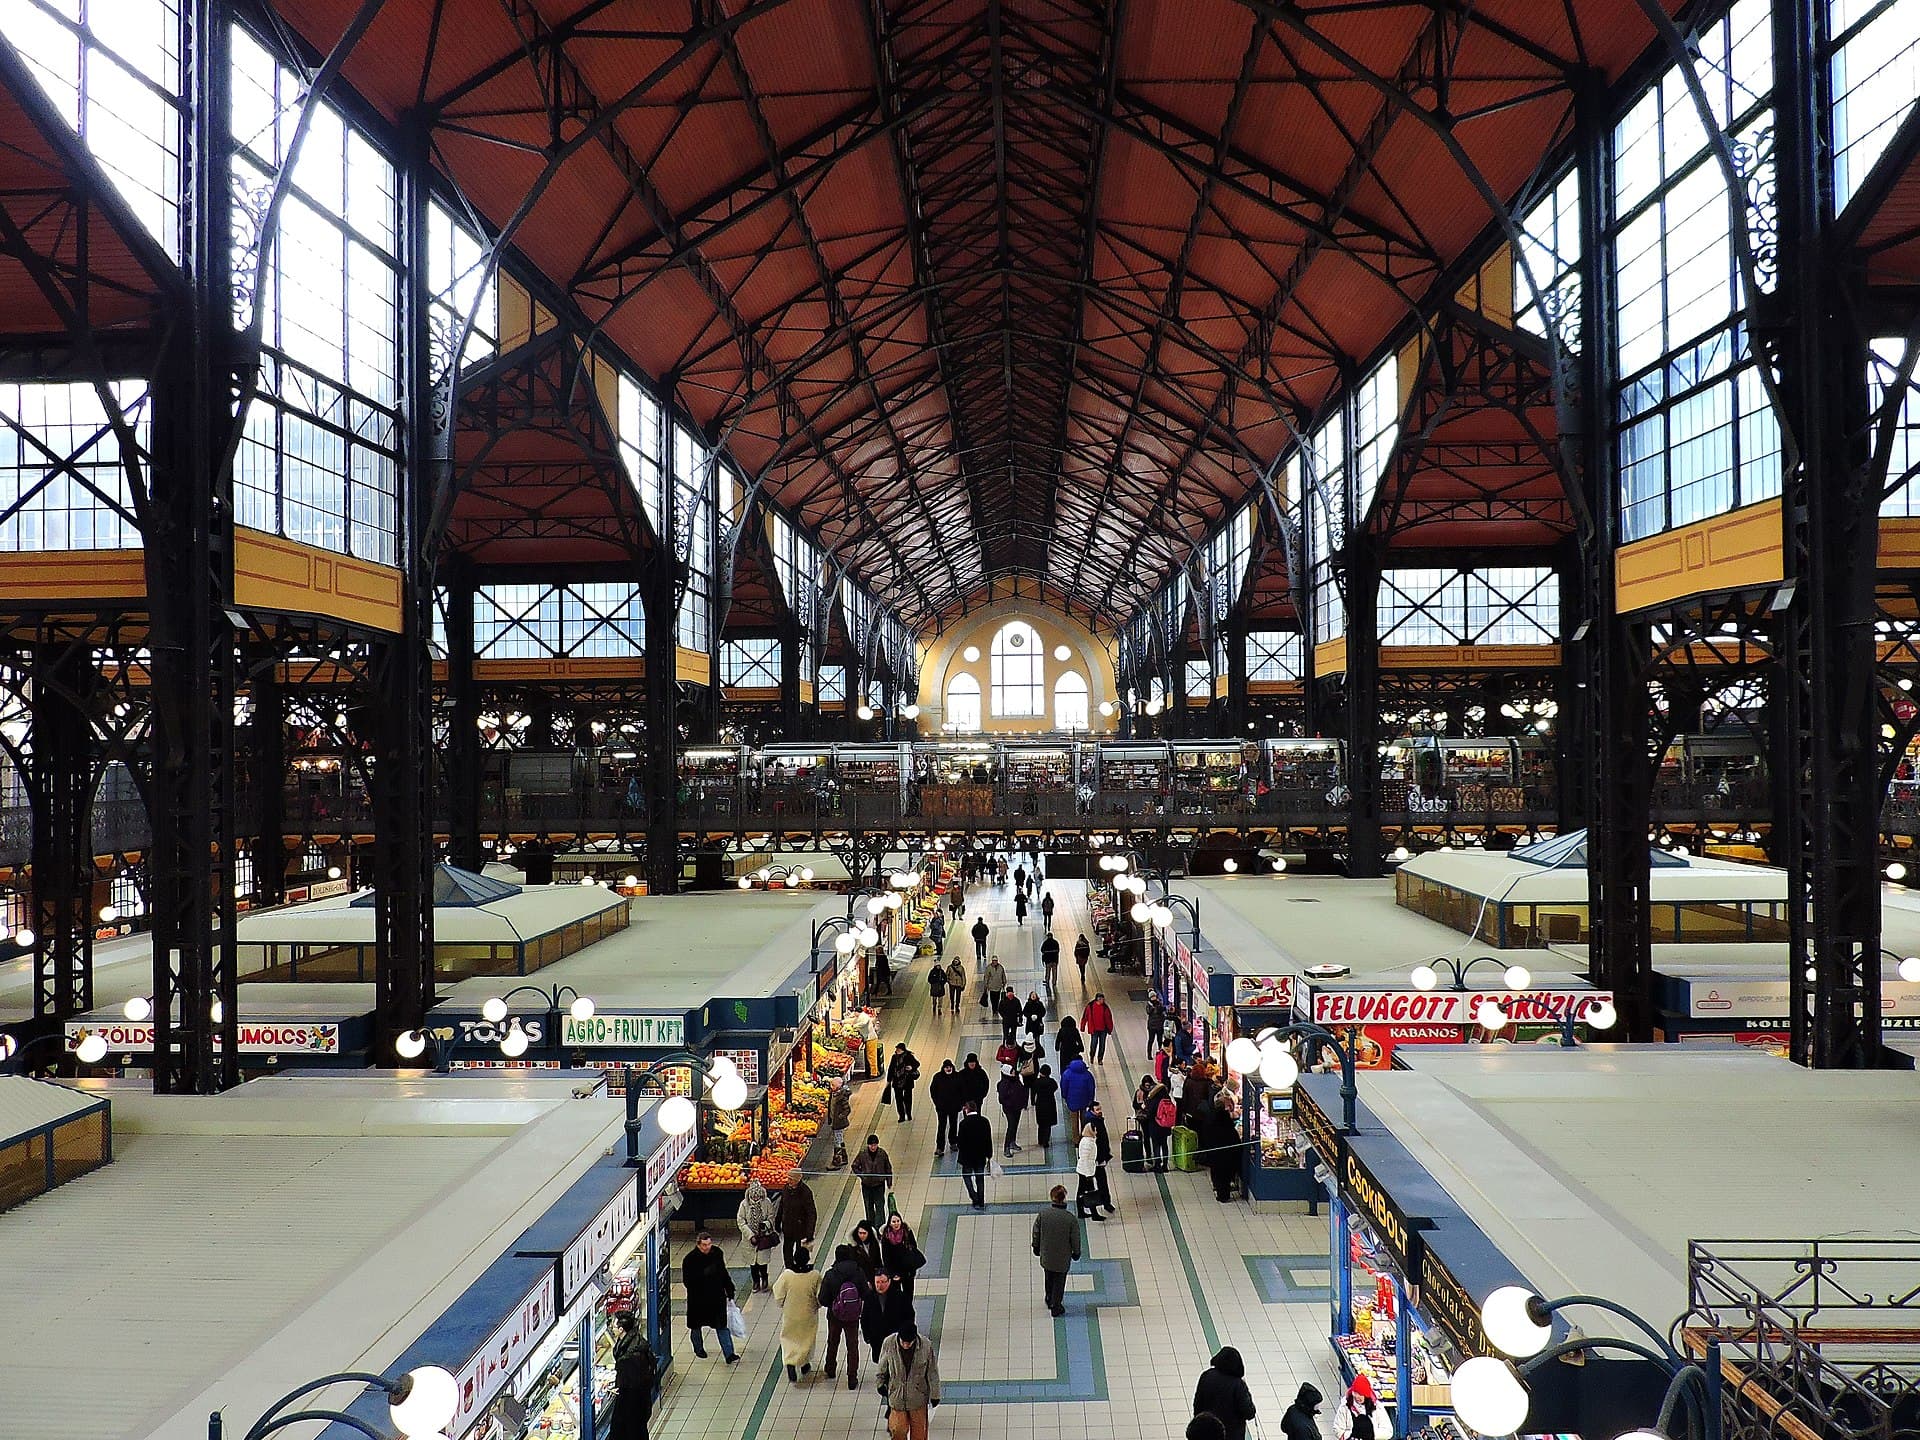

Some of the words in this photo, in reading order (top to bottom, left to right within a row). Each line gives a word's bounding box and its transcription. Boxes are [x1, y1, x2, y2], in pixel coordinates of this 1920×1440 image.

[1317, 993, 1459, 1020] FELVÁGOTT
[567, 1019, 652, 1042] AGRO-FRUIT
[657, 1020, 684, 1043] KFT.
[1390, 1028, 1458, 1038] KABANOS
[1422, 1258, 1464, 1327] Chocolate
[1467, 1318, 1475, 1339] &
